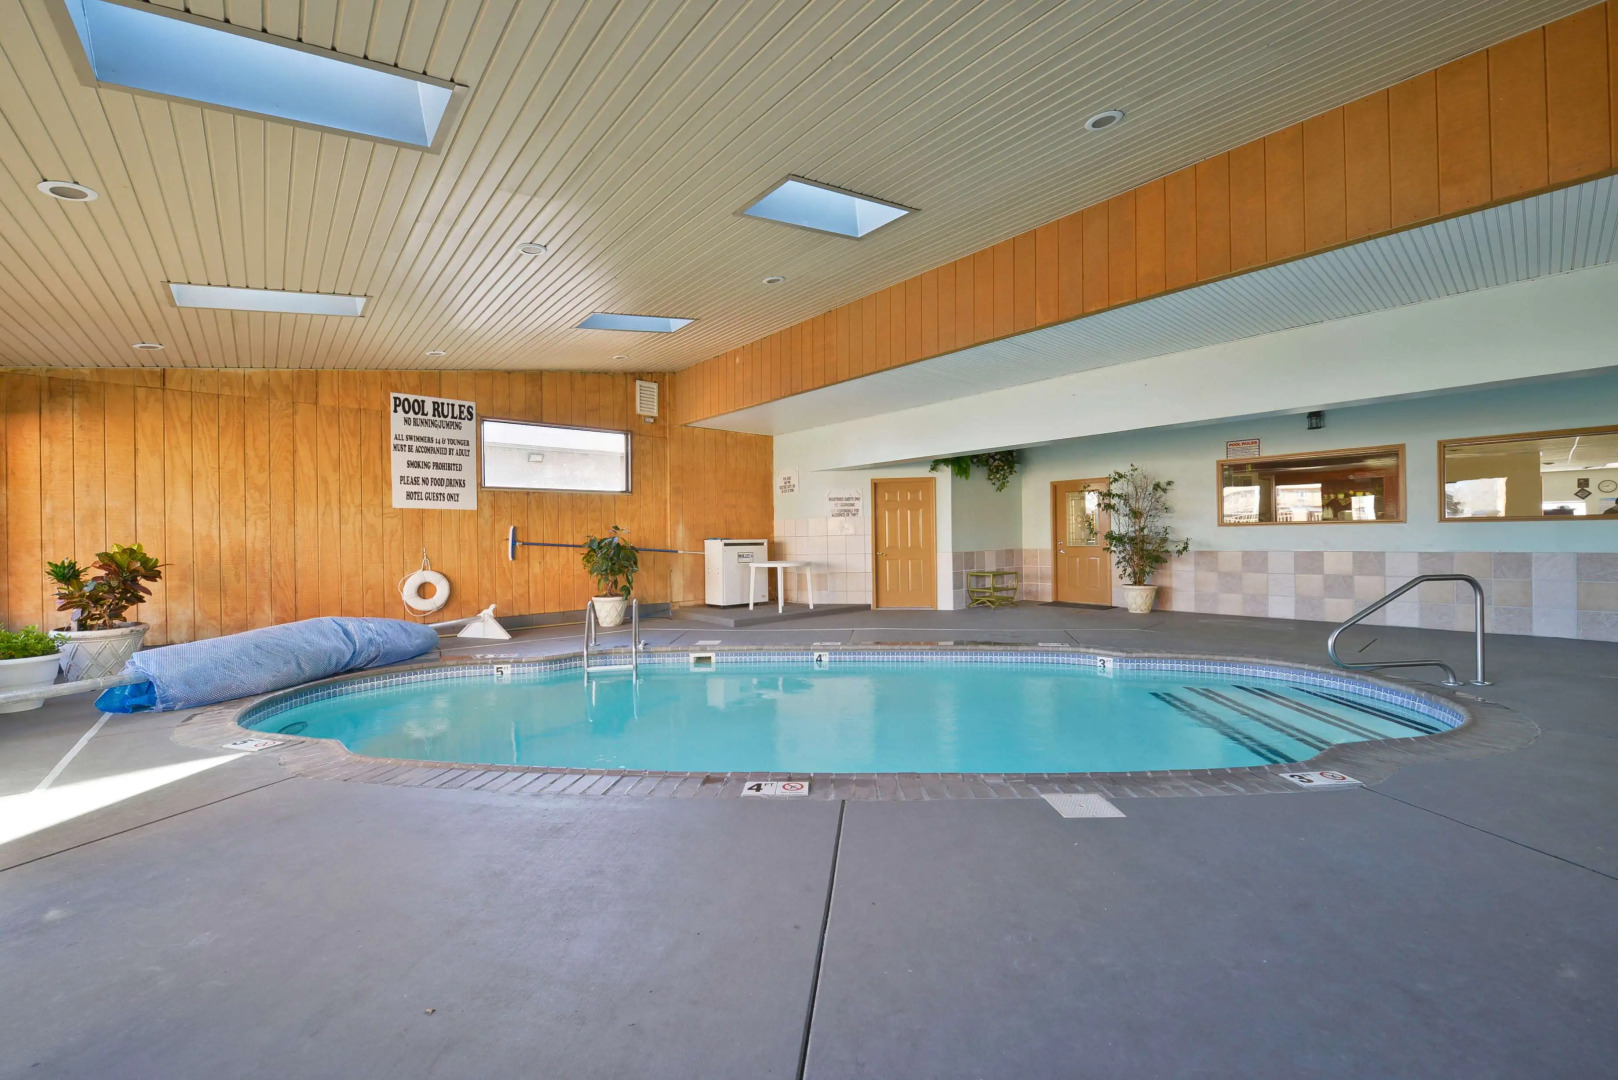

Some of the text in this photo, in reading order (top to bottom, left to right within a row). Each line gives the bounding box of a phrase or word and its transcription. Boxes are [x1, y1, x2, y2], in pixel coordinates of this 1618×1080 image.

[393, 396, 473, 421] POOL RULES
[404, 417, 462, 430] NO RUNNING/JUMPING
[406, 435, 434, 443] SWIMMERS
[393, 444, 406, 452] MUST
[415, 446, 447, 455] ACCOMPANIED
[407, 460, 462, 471] SMOKING PROHIBITED
[400, 476, 420, 485] PLEASE
[422, 477, 429, 486] NO
[406, 491, 460, 502] HOTEL GUESTS ONLY
[816, 654, 822, 662] 4
[1098, 658, 1106, 668] 3
[496, 667, 504, 675] 5
[1289, 774, 1313, 783] 3
[747, 783, 763, 792] 4
